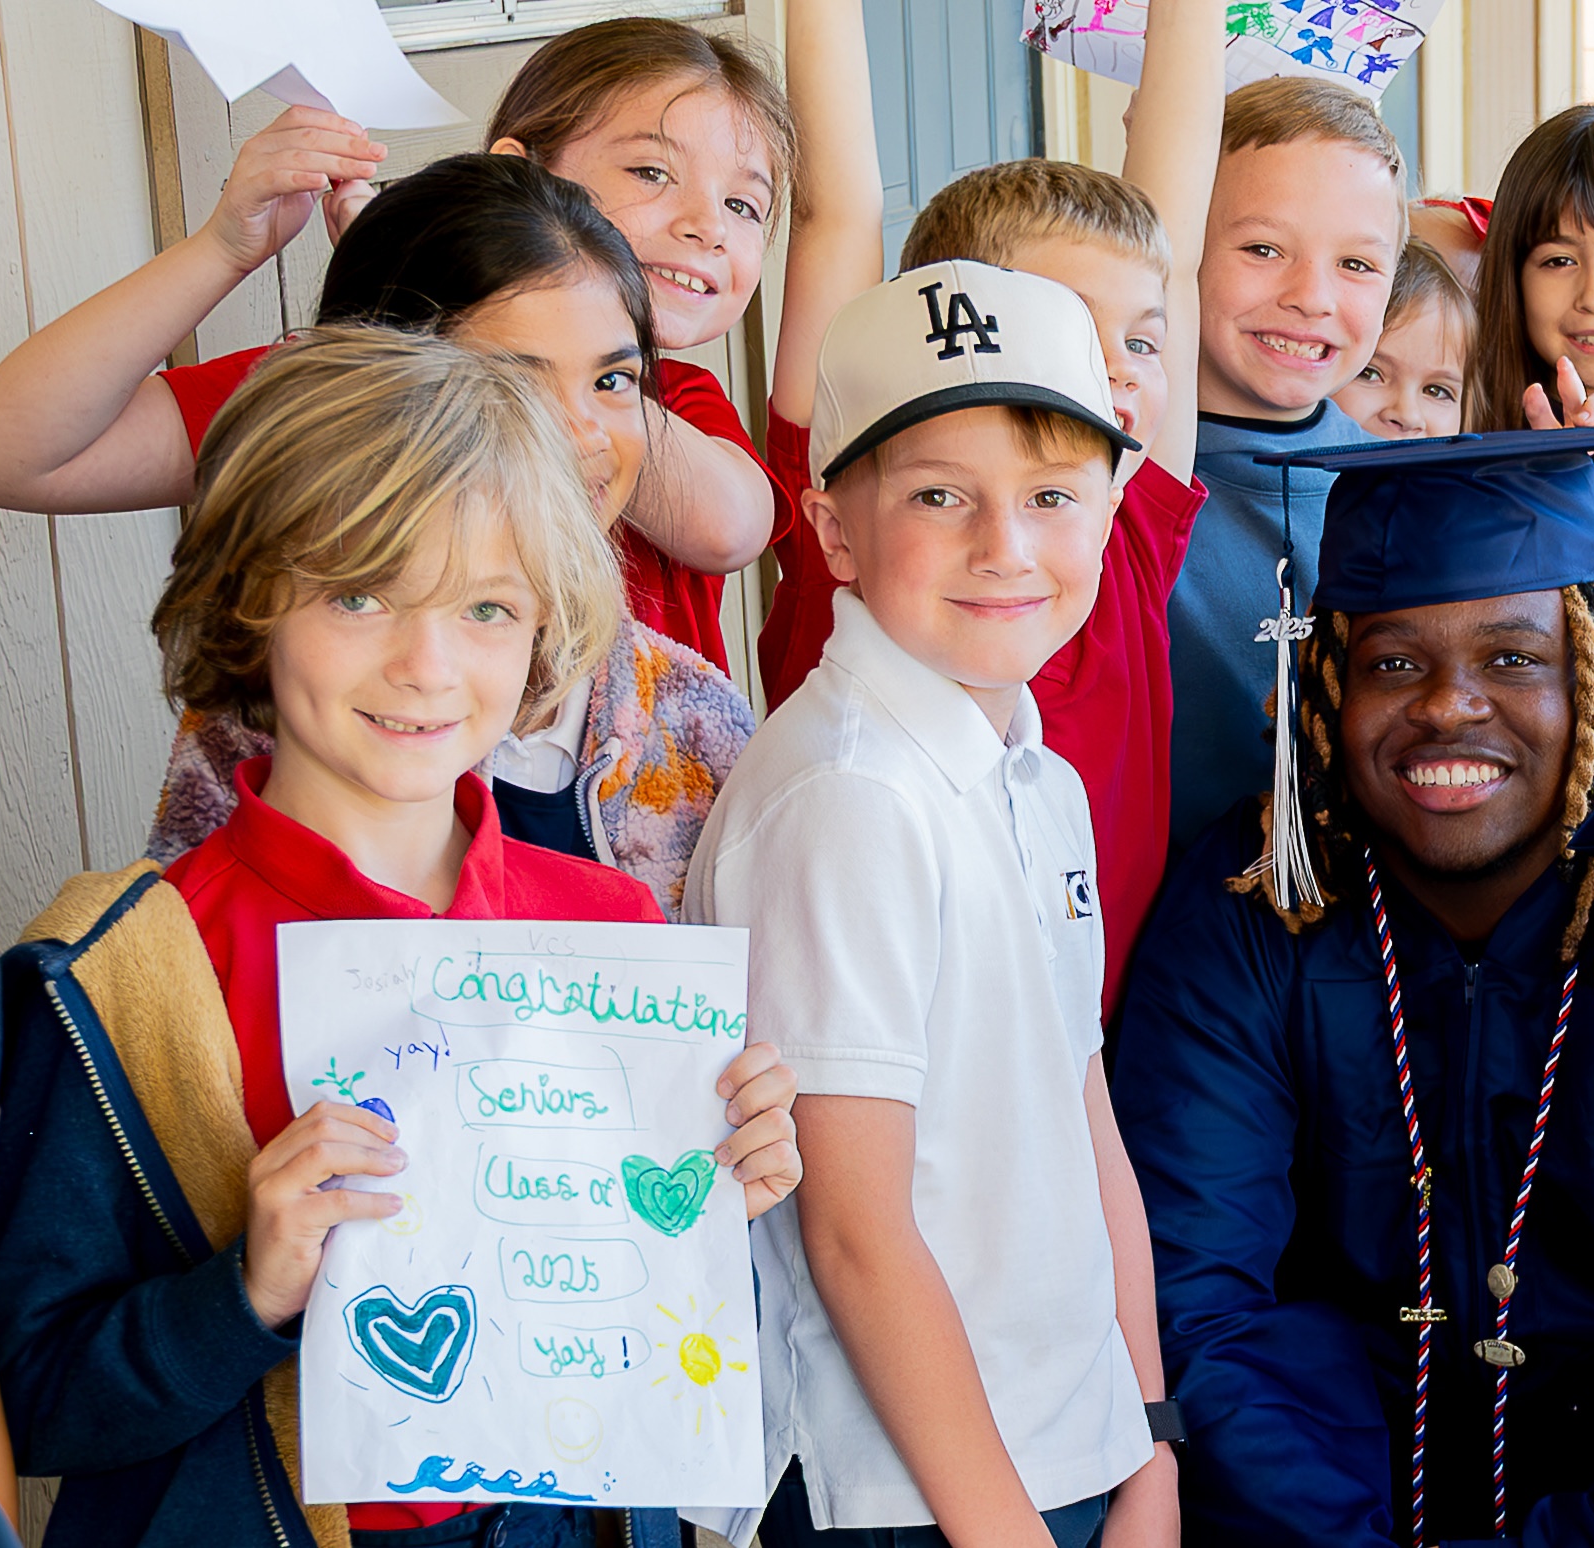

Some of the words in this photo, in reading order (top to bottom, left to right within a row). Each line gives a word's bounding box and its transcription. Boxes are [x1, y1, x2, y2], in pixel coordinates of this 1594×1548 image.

[918, 281, 1001, 361] LA
[485, 1155, 579, 1201] Class
[589, 1177, 617, 1208] of
[512, 1249, 600, 1293] 2025
